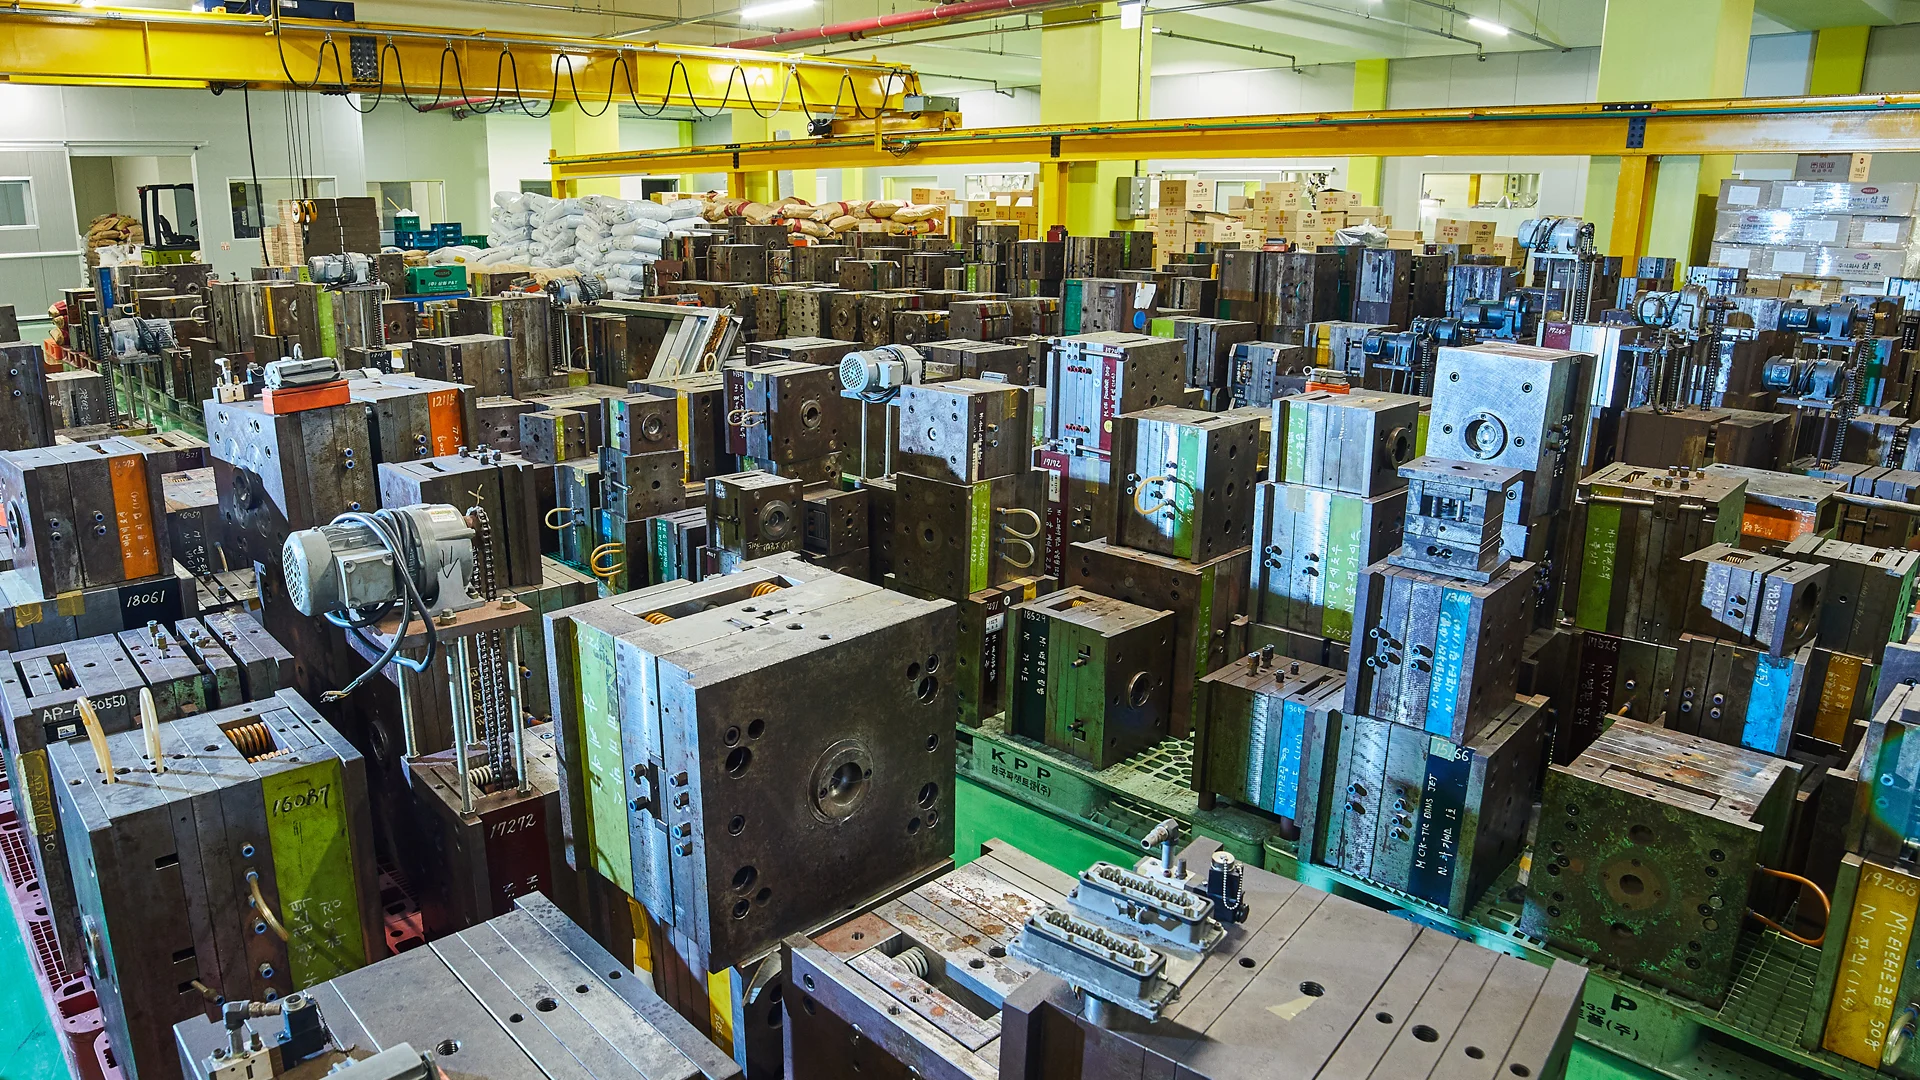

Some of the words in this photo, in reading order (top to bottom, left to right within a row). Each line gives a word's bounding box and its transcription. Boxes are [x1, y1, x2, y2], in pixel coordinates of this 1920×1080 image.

[126, 590, 166, 608] 18061
[1327, 594, 1337, 609] M:
[1344, 599, 1354, 612] N:
[1023, 610, 1046, 623] 18529
[1039, 636, 1046, 646] M:
[1601, 680, 1609, 696] VT
[43, 694, 127, 722] AP-A60550
[1434, 742, 1469, 761] 15166
[1428, 773, 1437, 791] JET
[273, 785, 331, 818] 16087
[490, 813, 536, 839] 17272
[1861, 904, 1876, 923] N:
[1886, 911, 1907, 934] M:
[1865, 1020, 1889, 1050] 50g
